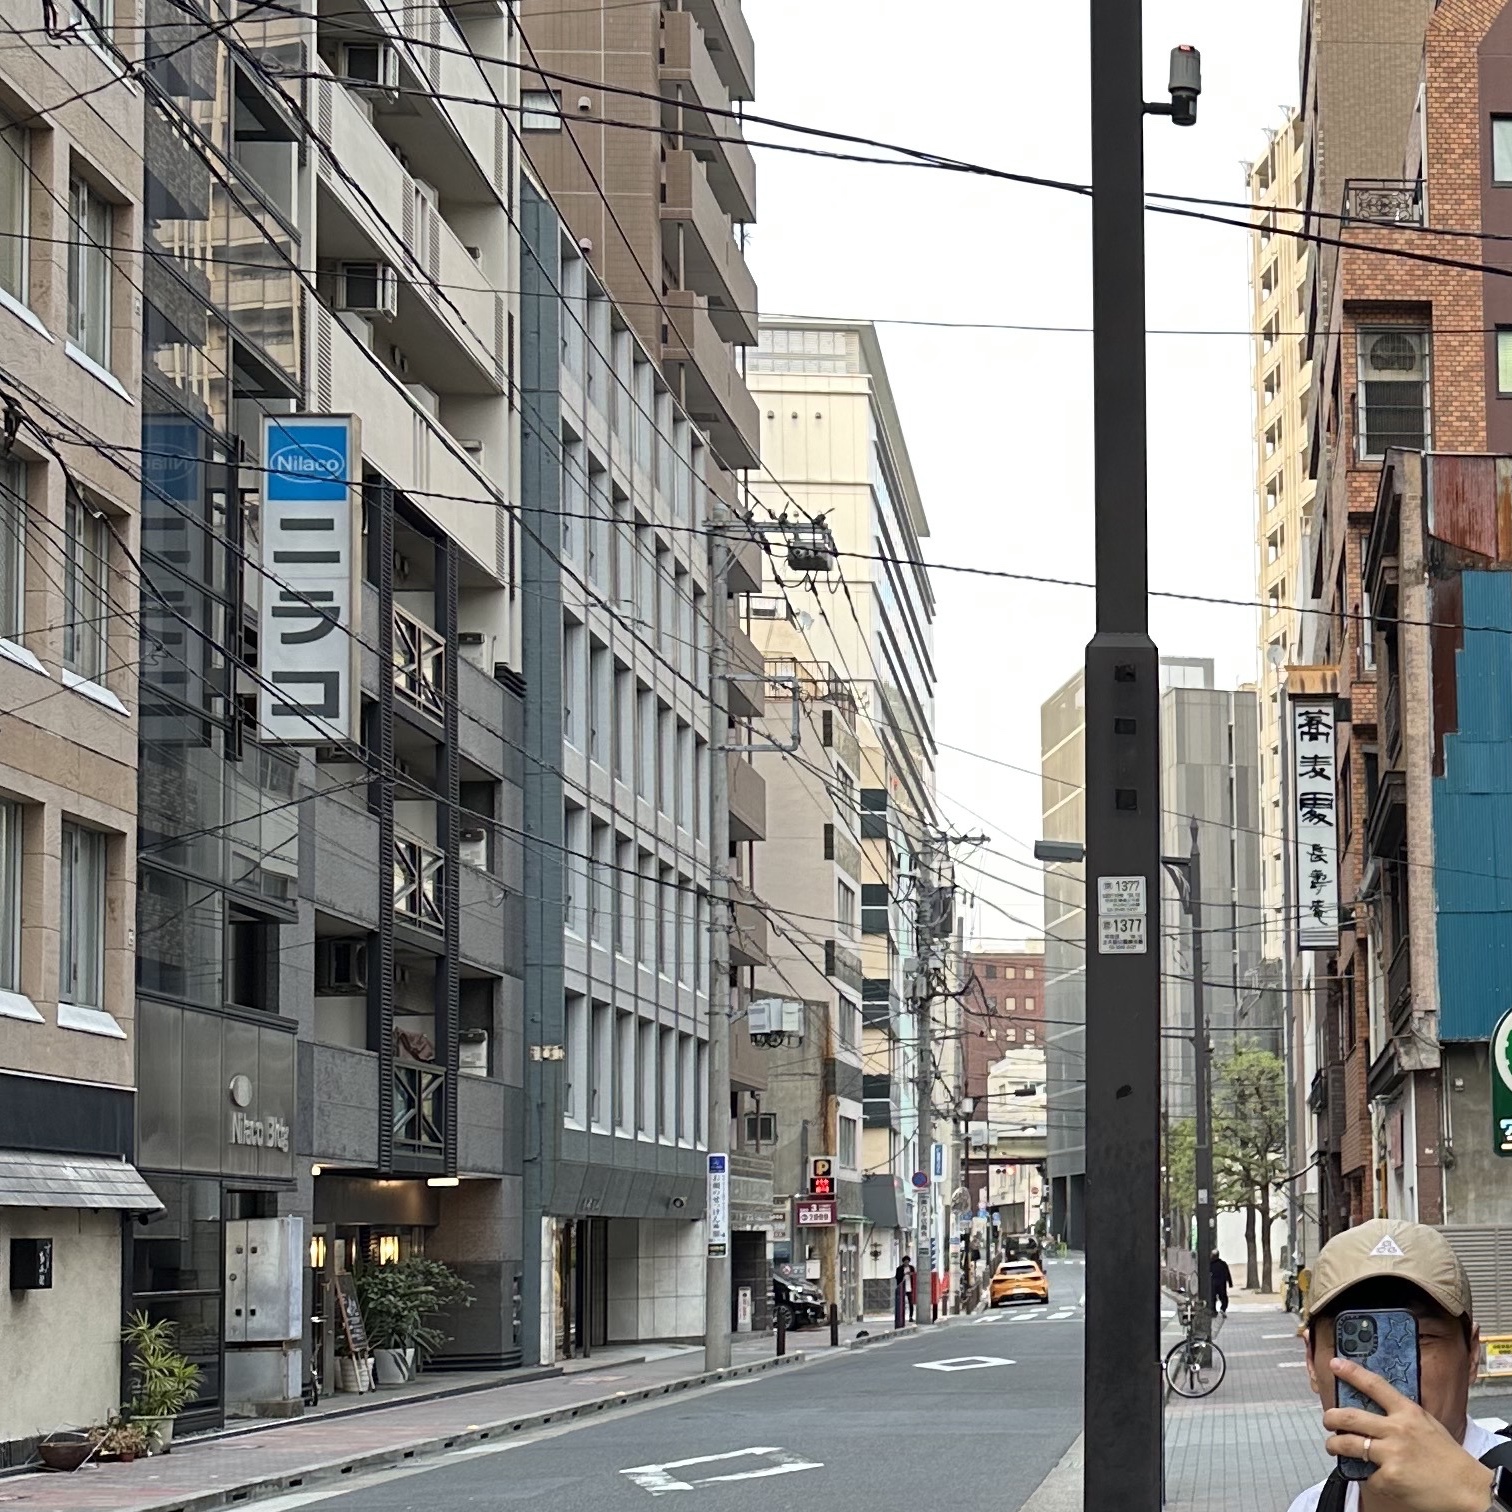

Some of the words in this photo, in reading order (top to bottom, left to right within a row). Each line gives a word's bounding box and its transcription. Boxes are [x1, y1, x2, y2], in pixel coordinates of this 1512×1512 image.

[277, 454, 339, 472] Nilaco
[272, 518, 341, 719] ニラコ
[1115, 880, 1140, 892] 1377
[1113, 918, 1142, 933] 1377
[816, 1160, 829, 1176] P
